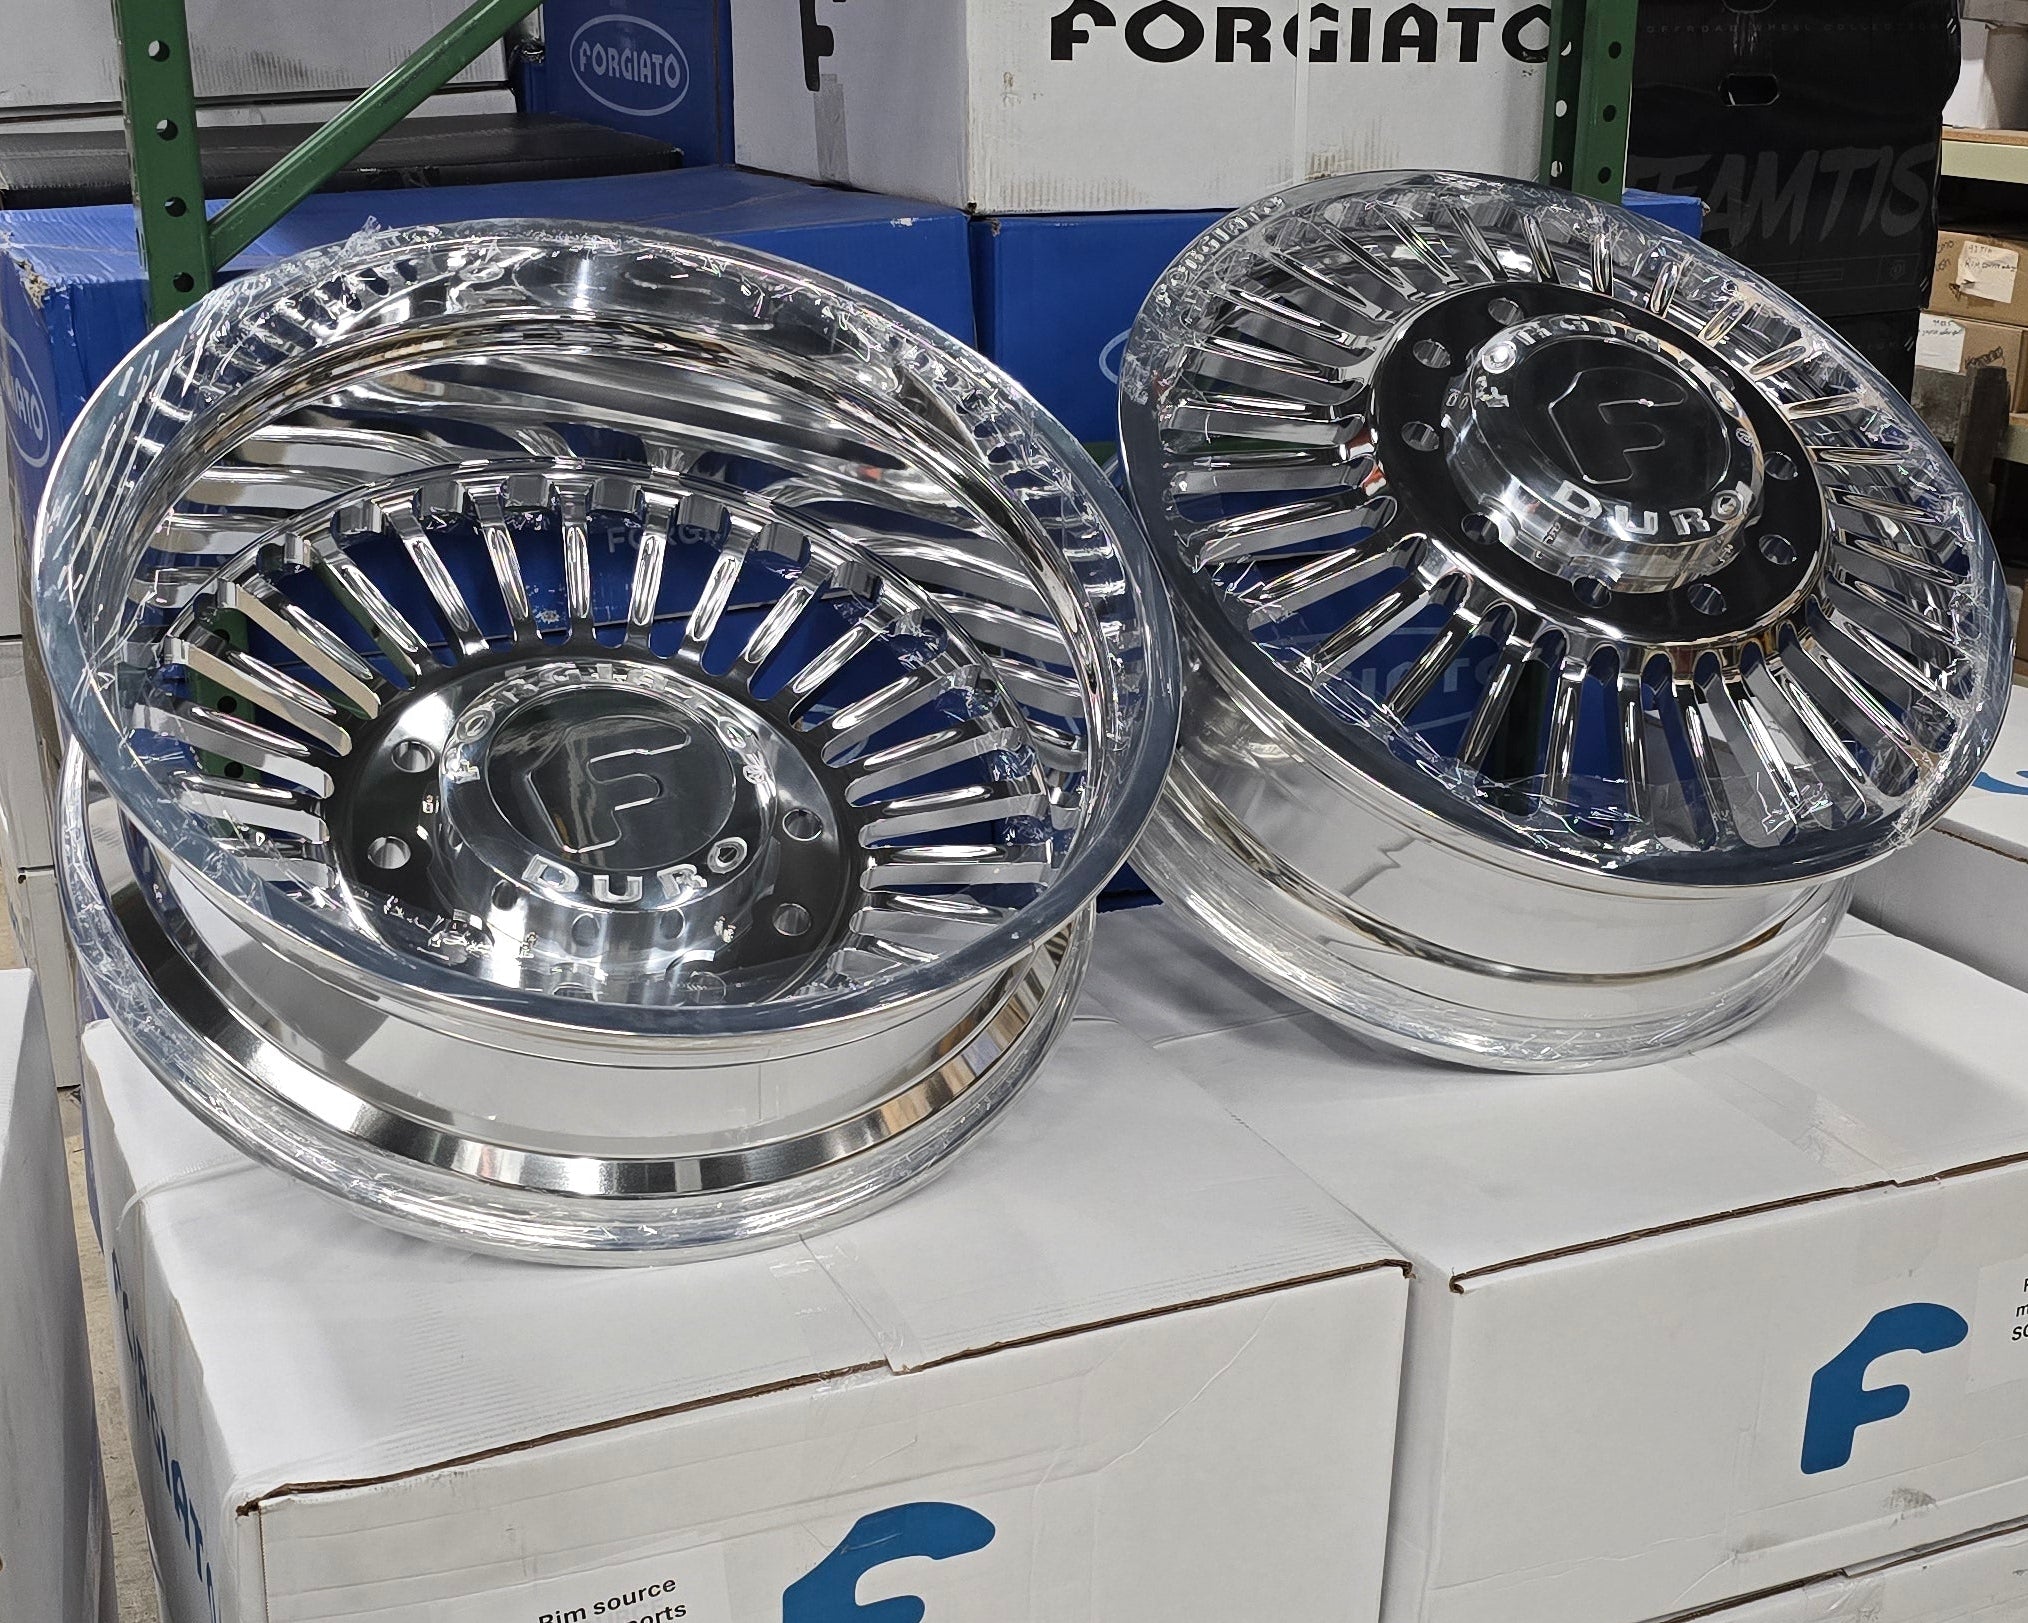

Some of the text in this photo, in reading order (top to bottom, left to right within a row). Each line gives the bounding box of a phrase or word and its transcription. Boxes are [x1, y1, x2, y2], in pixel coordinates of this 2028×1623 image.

[1050, 0, 1549, 64] FORGIATO
[579, 40, 681, 89] FORGIATO
[1553, 479, 1743, 537] DURO
[521, 836, 749, 904] DURO
[1800, 1302, 1969, 1476] F
[593, 1579, 677, 1616] source
